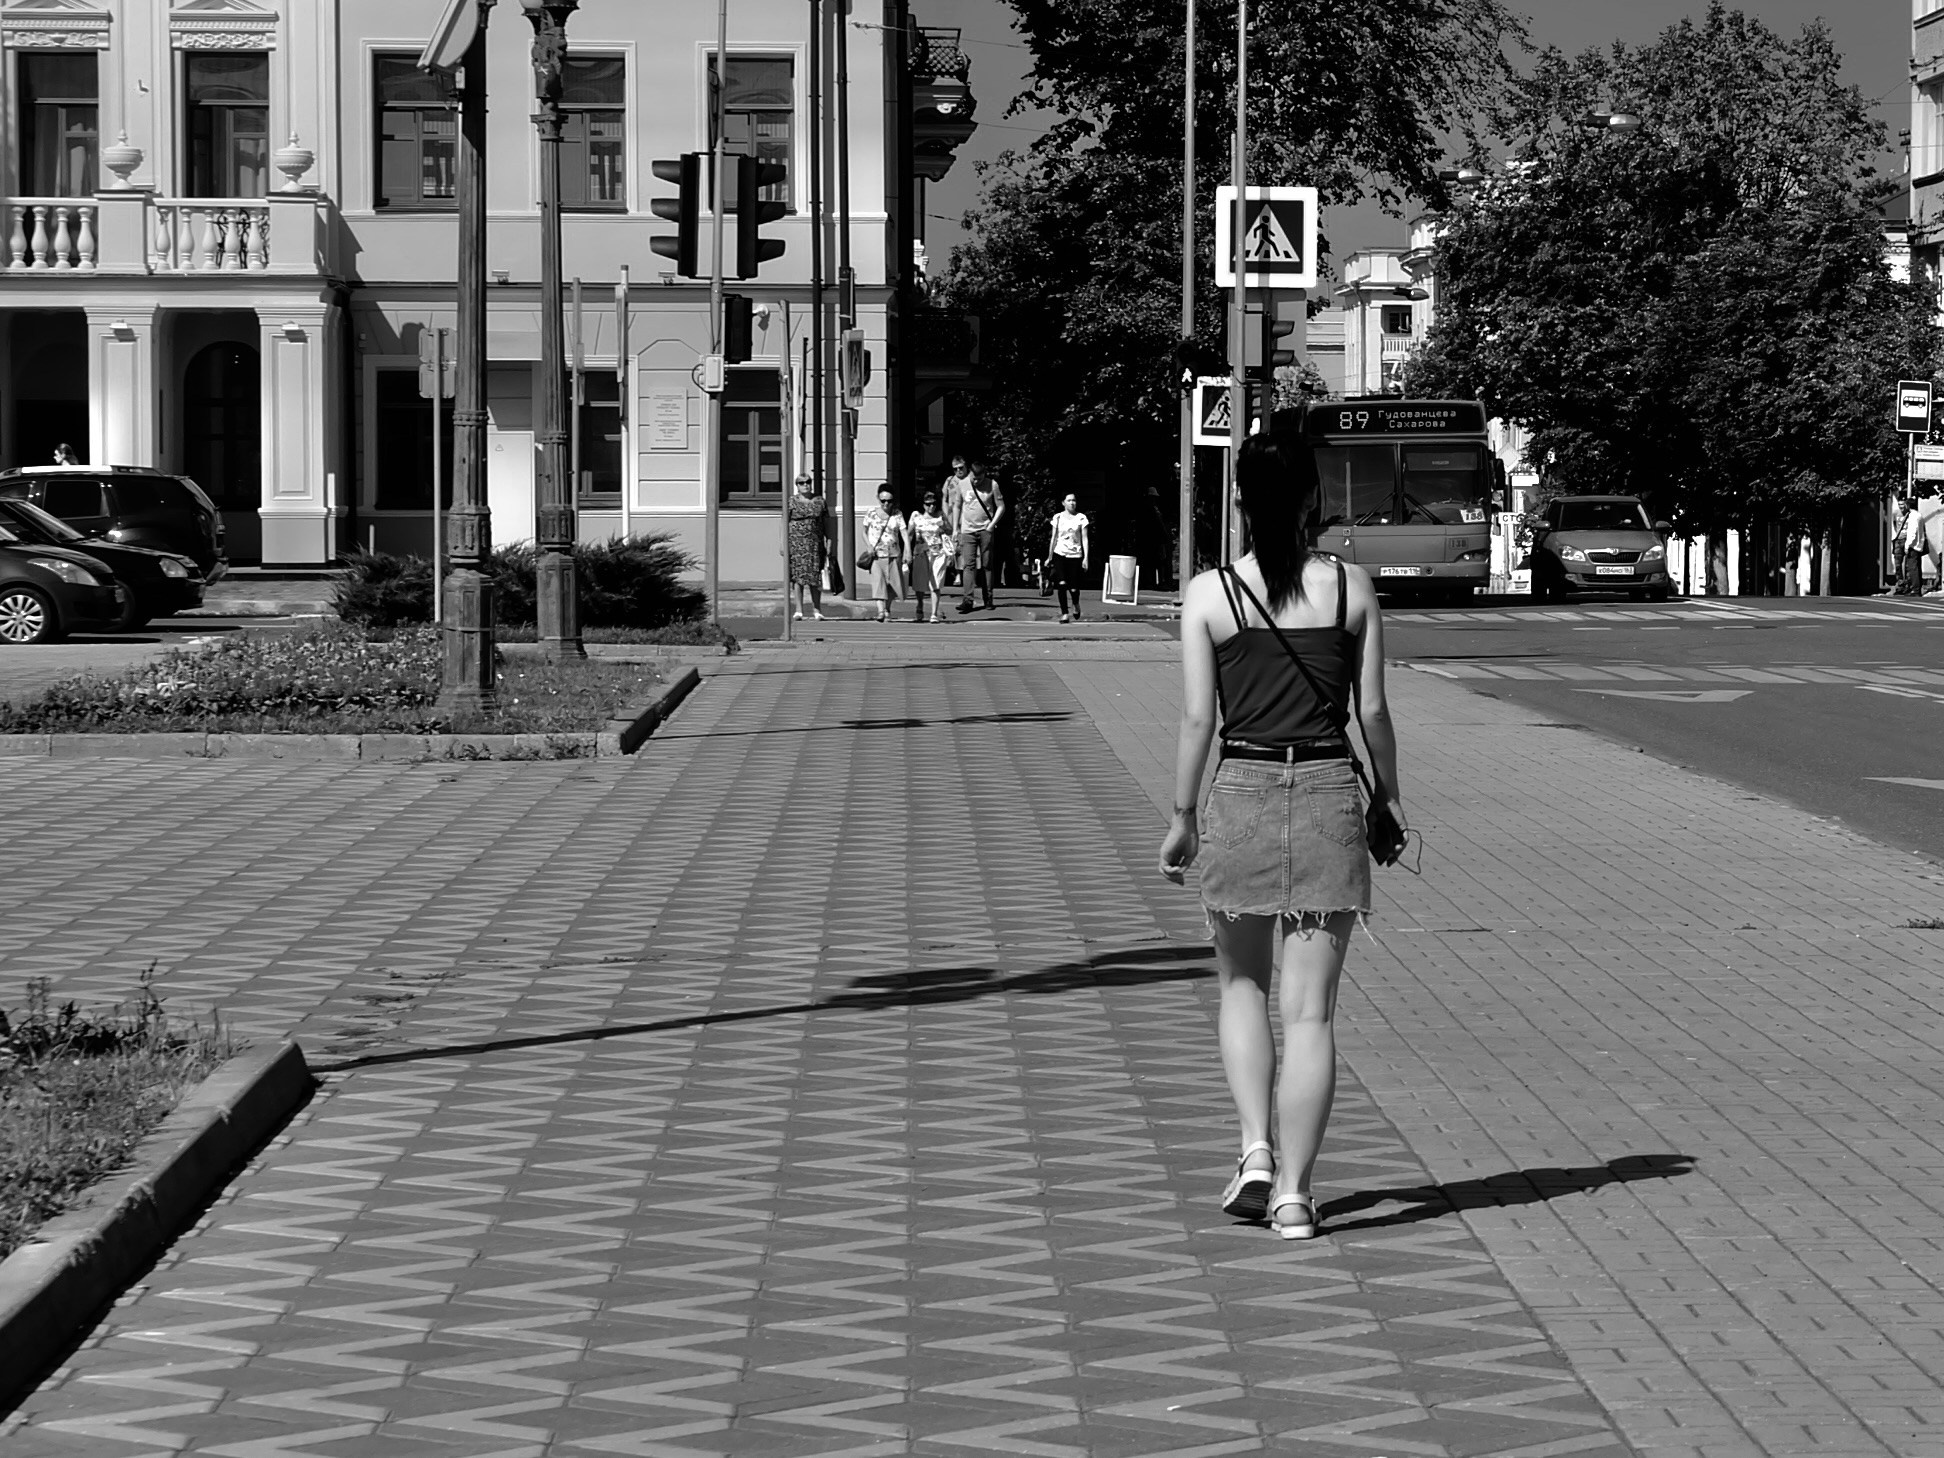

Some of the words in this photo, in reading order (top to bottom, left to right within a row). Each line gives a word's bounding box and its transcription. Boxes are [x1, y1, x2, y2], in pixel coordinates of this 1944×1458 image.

[1340, 411, 1369, 429] 89
[1378, 410, 1457, 420] Гудованцева
[1389, 420, 1446, 429] Сахарова
